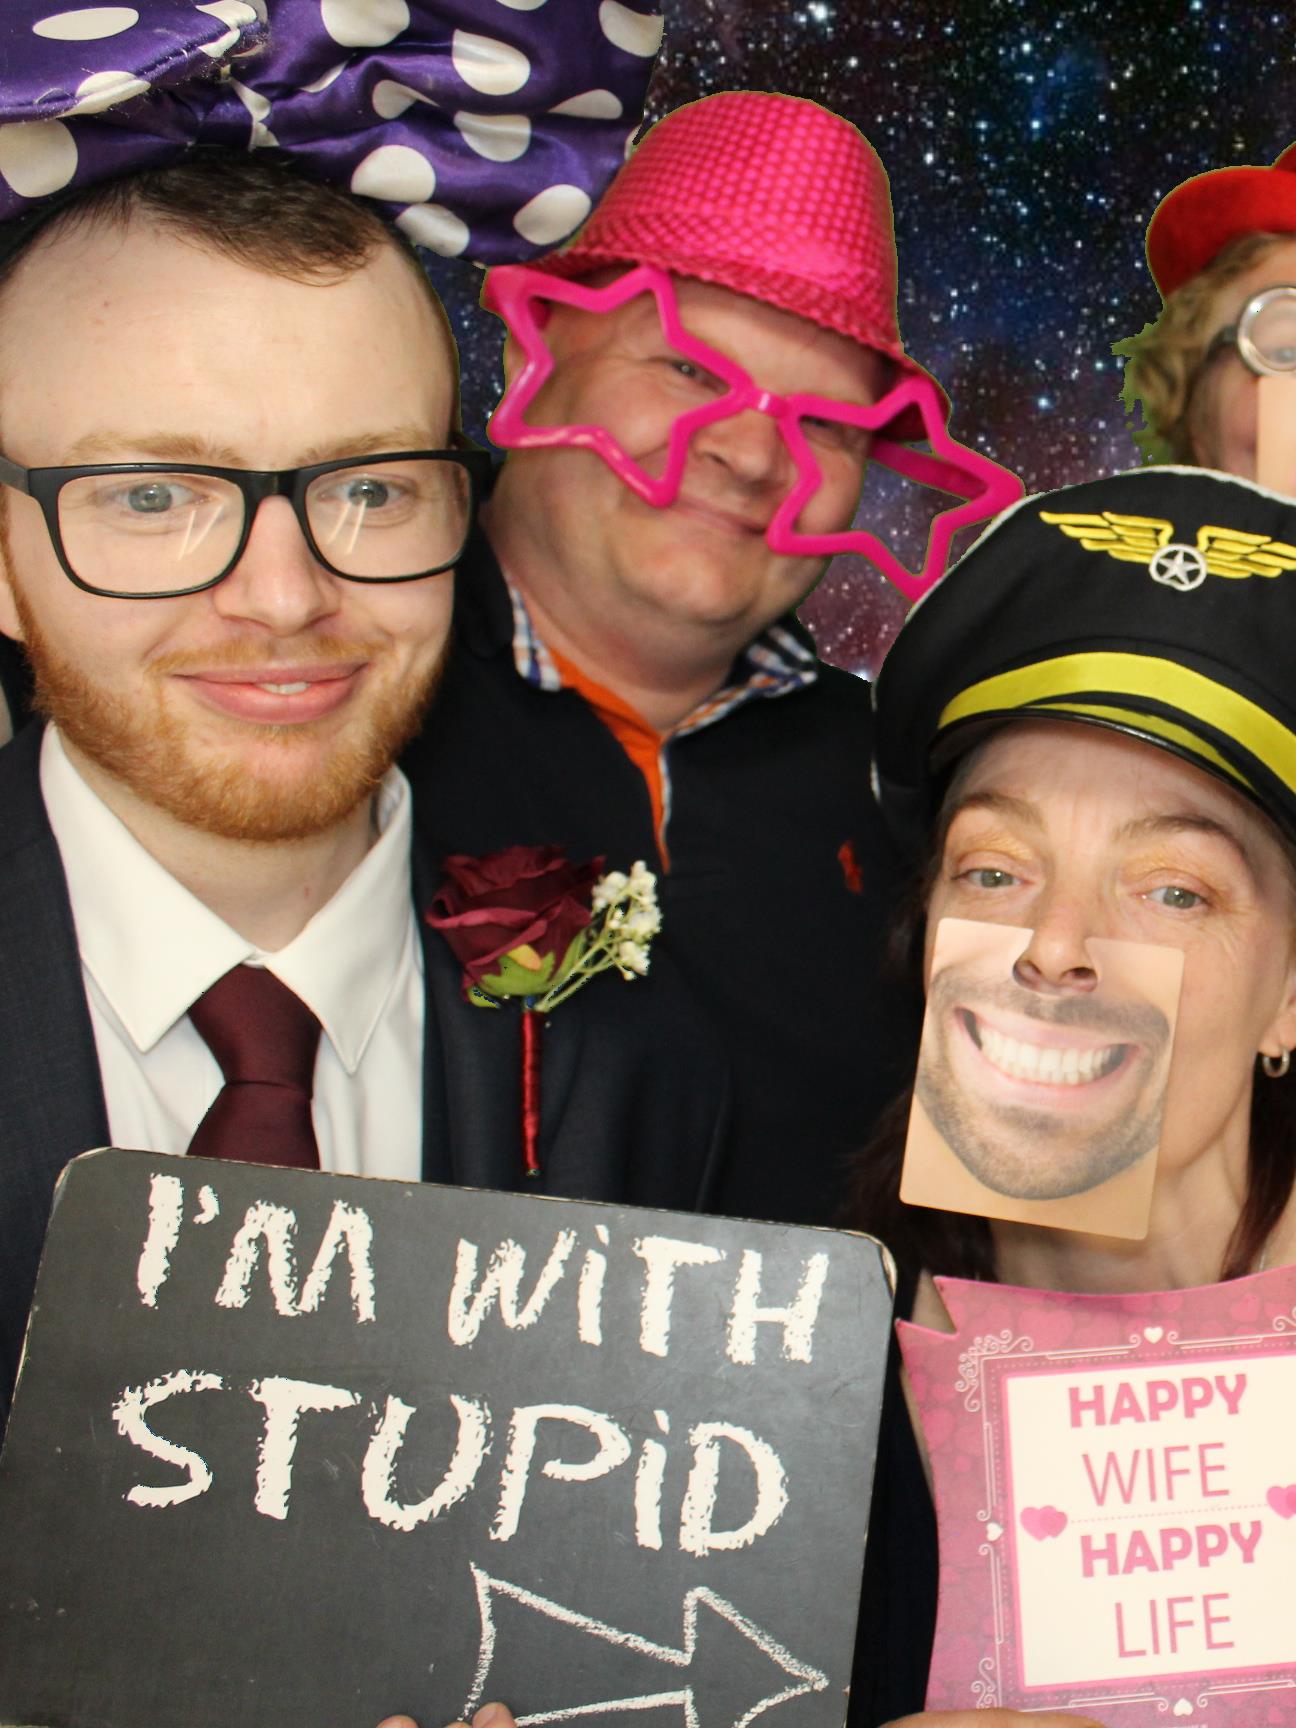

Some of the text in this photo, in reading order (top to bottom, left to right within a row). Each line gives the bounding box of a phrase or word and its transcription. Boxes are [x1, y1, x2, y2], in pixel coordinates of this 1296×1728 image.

[136, 1173, 376, 1322] I'M
[1068, 1374, 1247, 1428] HAPPY
[1082, 1442, 1230, 1507] WIFE
[1080, 1520, 1263, 1578] HAPPY
[1115, 1593, 1235, 1659] LIFE
